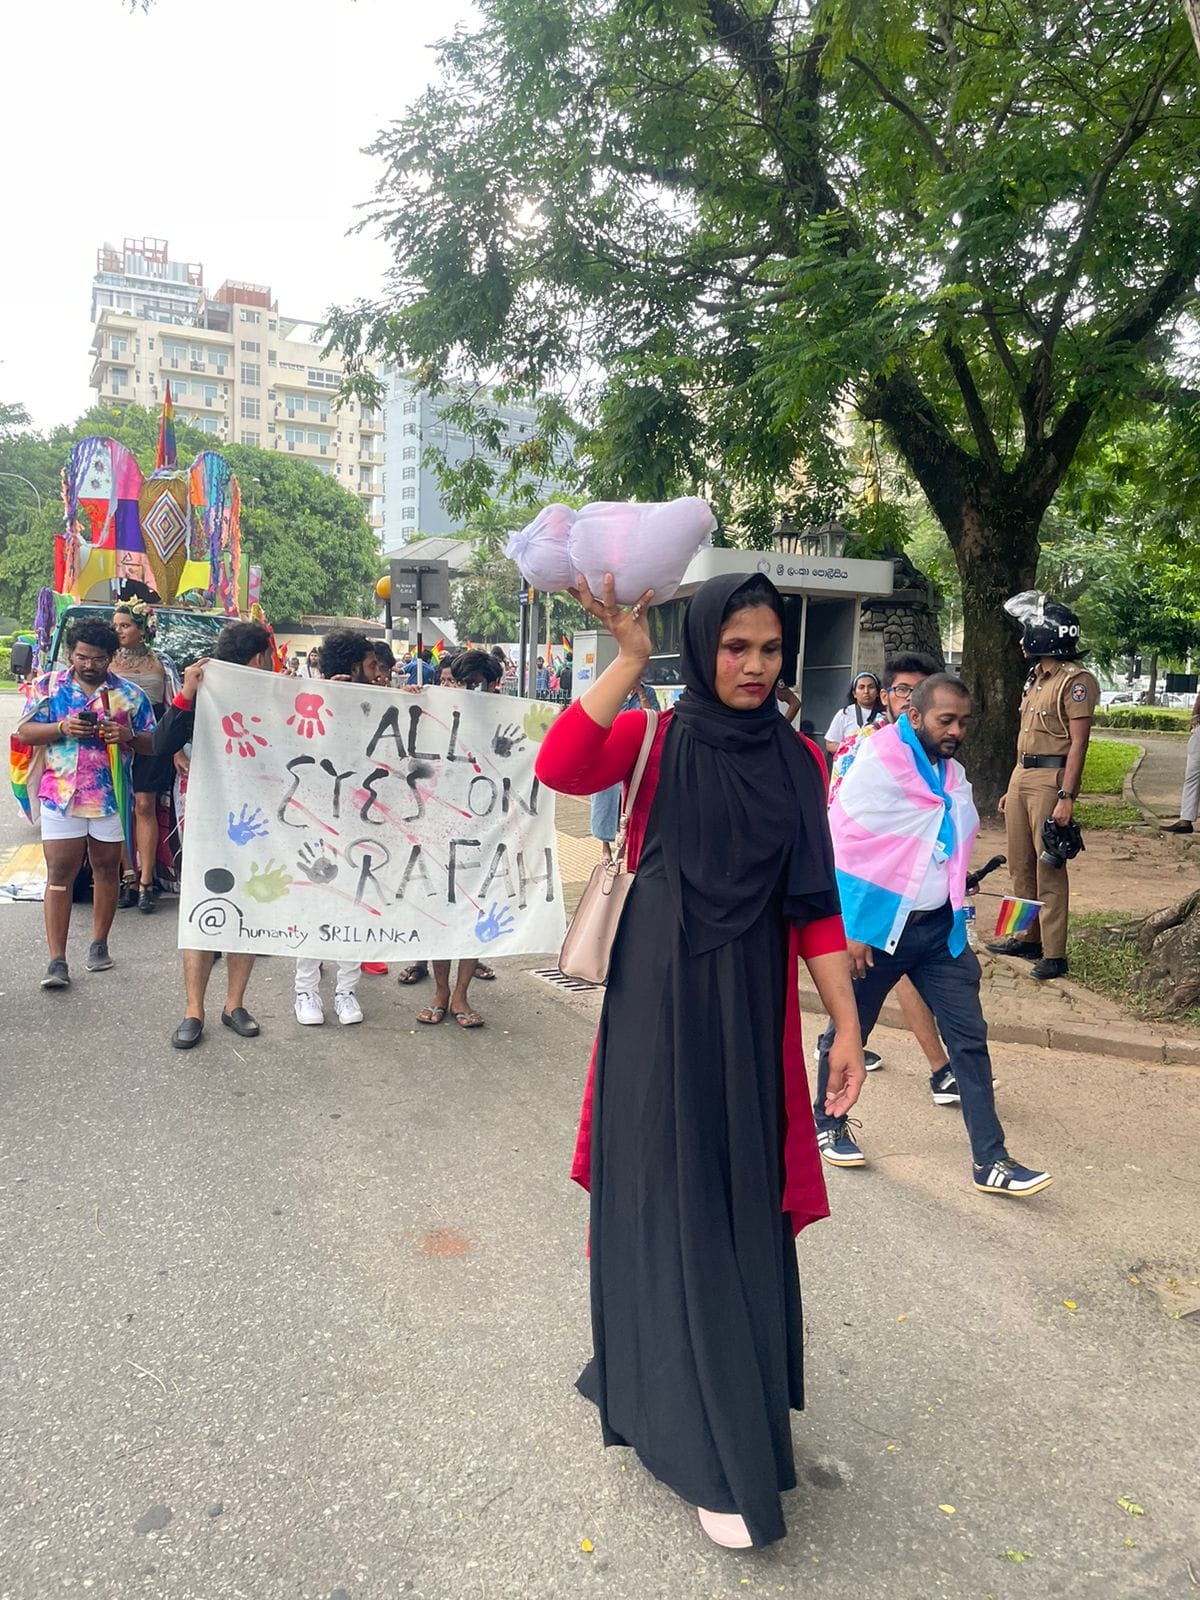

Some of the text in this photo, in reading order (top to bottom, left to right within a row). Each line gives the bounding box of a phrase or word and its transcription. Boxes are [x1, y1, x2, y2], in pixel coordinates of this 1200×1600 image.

[366, 705, 476, 763] ALL
[277, 755, 540, 828] EYES ON
[345, 838, 554, 910] RAFAH
